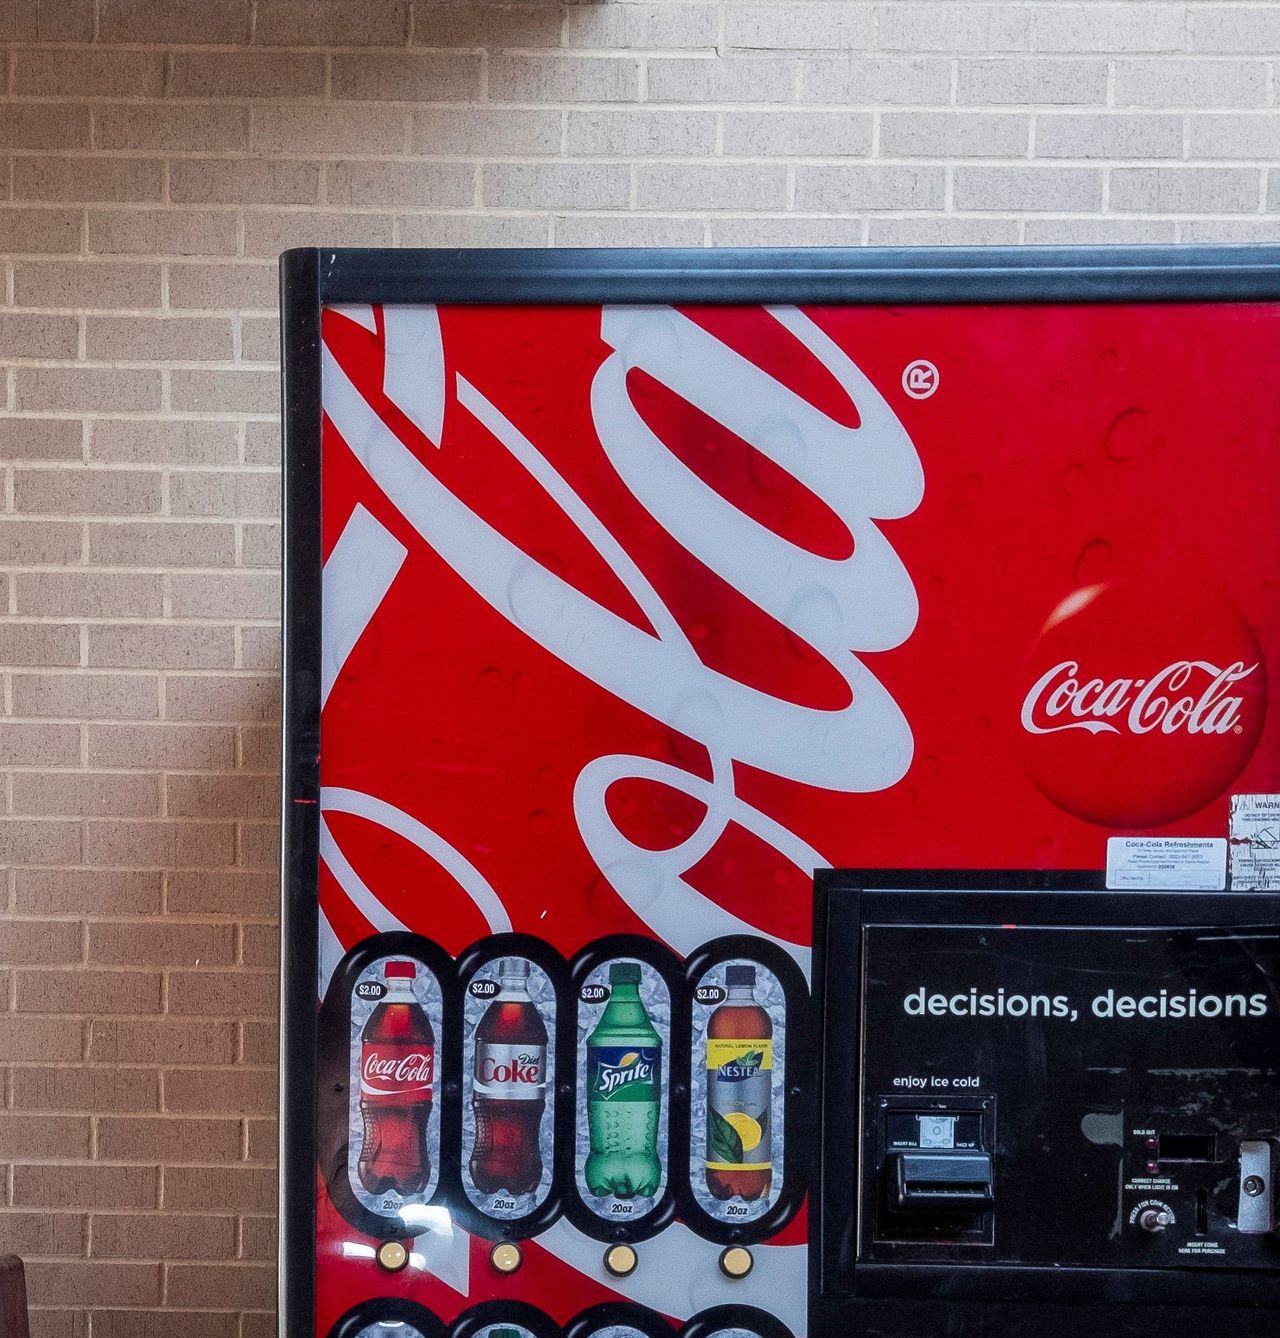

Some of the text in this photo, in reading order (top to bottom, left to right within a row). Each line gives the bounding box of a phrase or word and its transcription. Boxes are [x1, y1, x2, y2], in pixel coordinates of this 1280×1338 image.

[1021, 661, 1259, 735] Coca-Cola
[359, 984, 381, 996] $2.00
[472, 983, 495, 995] $2.00
[582, 987, 604, 1000] $2.00
[697, 988, 720, 1000] $2.00
[904, 987, 1268, 1022] decisions, decisions
[518, 1053, 540, 1065] Diet
[364, 1053, 432, 1081] Coca-Cola
[479, 1057, 539, 1083] Coke
[717, 1066, 760, 1077] NESTEA
[599, 1060, 650, 1092] Sprite
[893, 1075, 980, 1088] enjoy ice cold
[493, 1199, 515, 1210] 20oz
[611, 1203, 633, 1214] 20oz
[726, 1205, 748, 1215] 20oz
